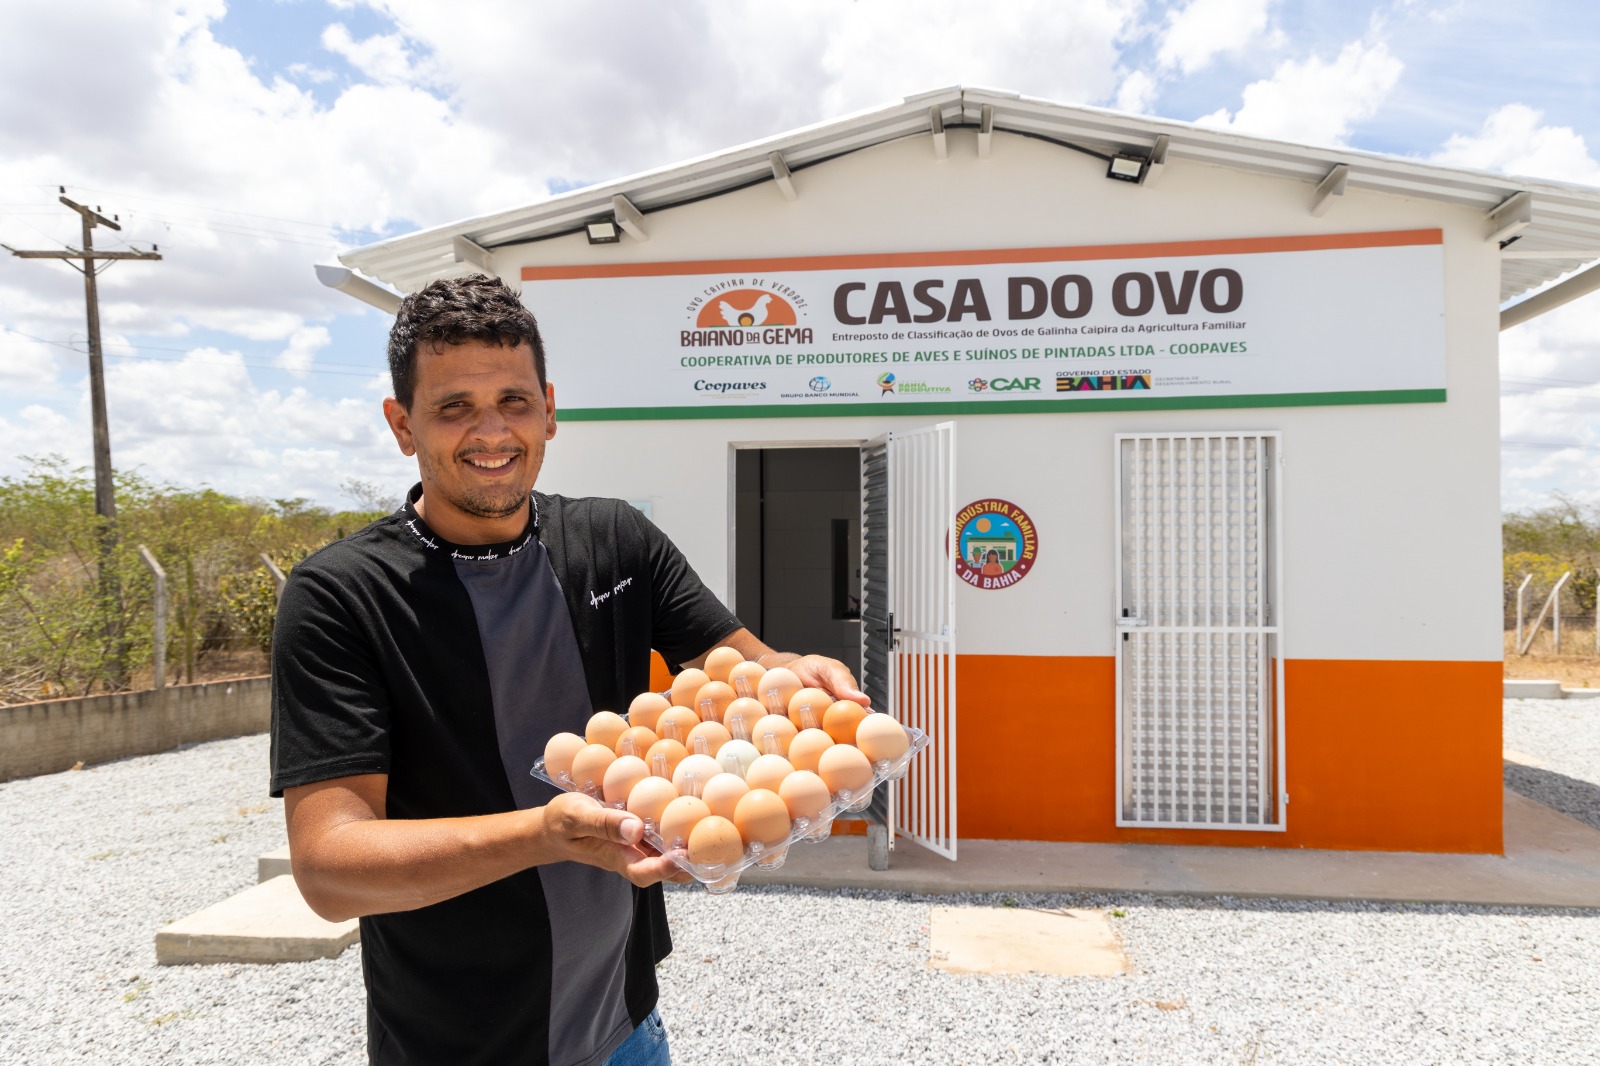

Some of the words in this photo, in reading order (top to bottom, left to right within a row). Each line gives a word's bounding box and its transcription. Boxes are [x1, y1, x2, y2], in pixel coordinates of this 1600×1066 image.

[686, 297, 702, 312] OVO
[704, 279, 744, 296] CAIPIRA
[772, 282, 808, 309] VERDADE
[834, 278, 992, 325] CASA
[1008, 274, 1093, 320] DO
[1112, 268, 1243, 316] OVO
[680, 329, 744, 347] BAIANO
[746, 332, 760, 342] DA
[763, 328, 813, 345] GEMA
[832, 331, 889, 342] Entreposto
[892, 331, 904, 340] de
[908, 329, 973, 340] Classificação
[976, 329, 990, 338] de
[992, 328, 1018, 337] Ovos
[1021, 328, 1035, 336] de
[1038, 326, 1078, 336] Galinha
[1080, 325, 1118, 335] Caipira
[1121, 324, 1134, 333] da
[1138, 322, 1199, 333] Agricultura
[1202, 321, 1246, 330] Familiar
[680, 354, 771, 367] COOPERATIVA
[776, 354, 792, 365] DE
[797, 352, 888, 364] PRODUTORES
[893, 352, 909, 362] DE
[914, 350, 949, 361] AVES
[954, 350, 960, 360] E
[966, 348, 1017, 360] SUÍNOS
[1022, 348, 1040, 359] DE
[1044, 346, 1115, 358] PINTADAS
[1120, 345, 1155, 356] LTDA
[1170, 342, 1247, 355] COOPAVES
[694, 380, 767, 392] Coopaves
[990, 377, 1041, 391] CAR
[1056, 375, 1151, 392] BAHIA
[1010, 509, 1035, 560] FAMILIAR
[962, 569, 979, 586] DA
[983, 570, 1021, 588] BAHIA
